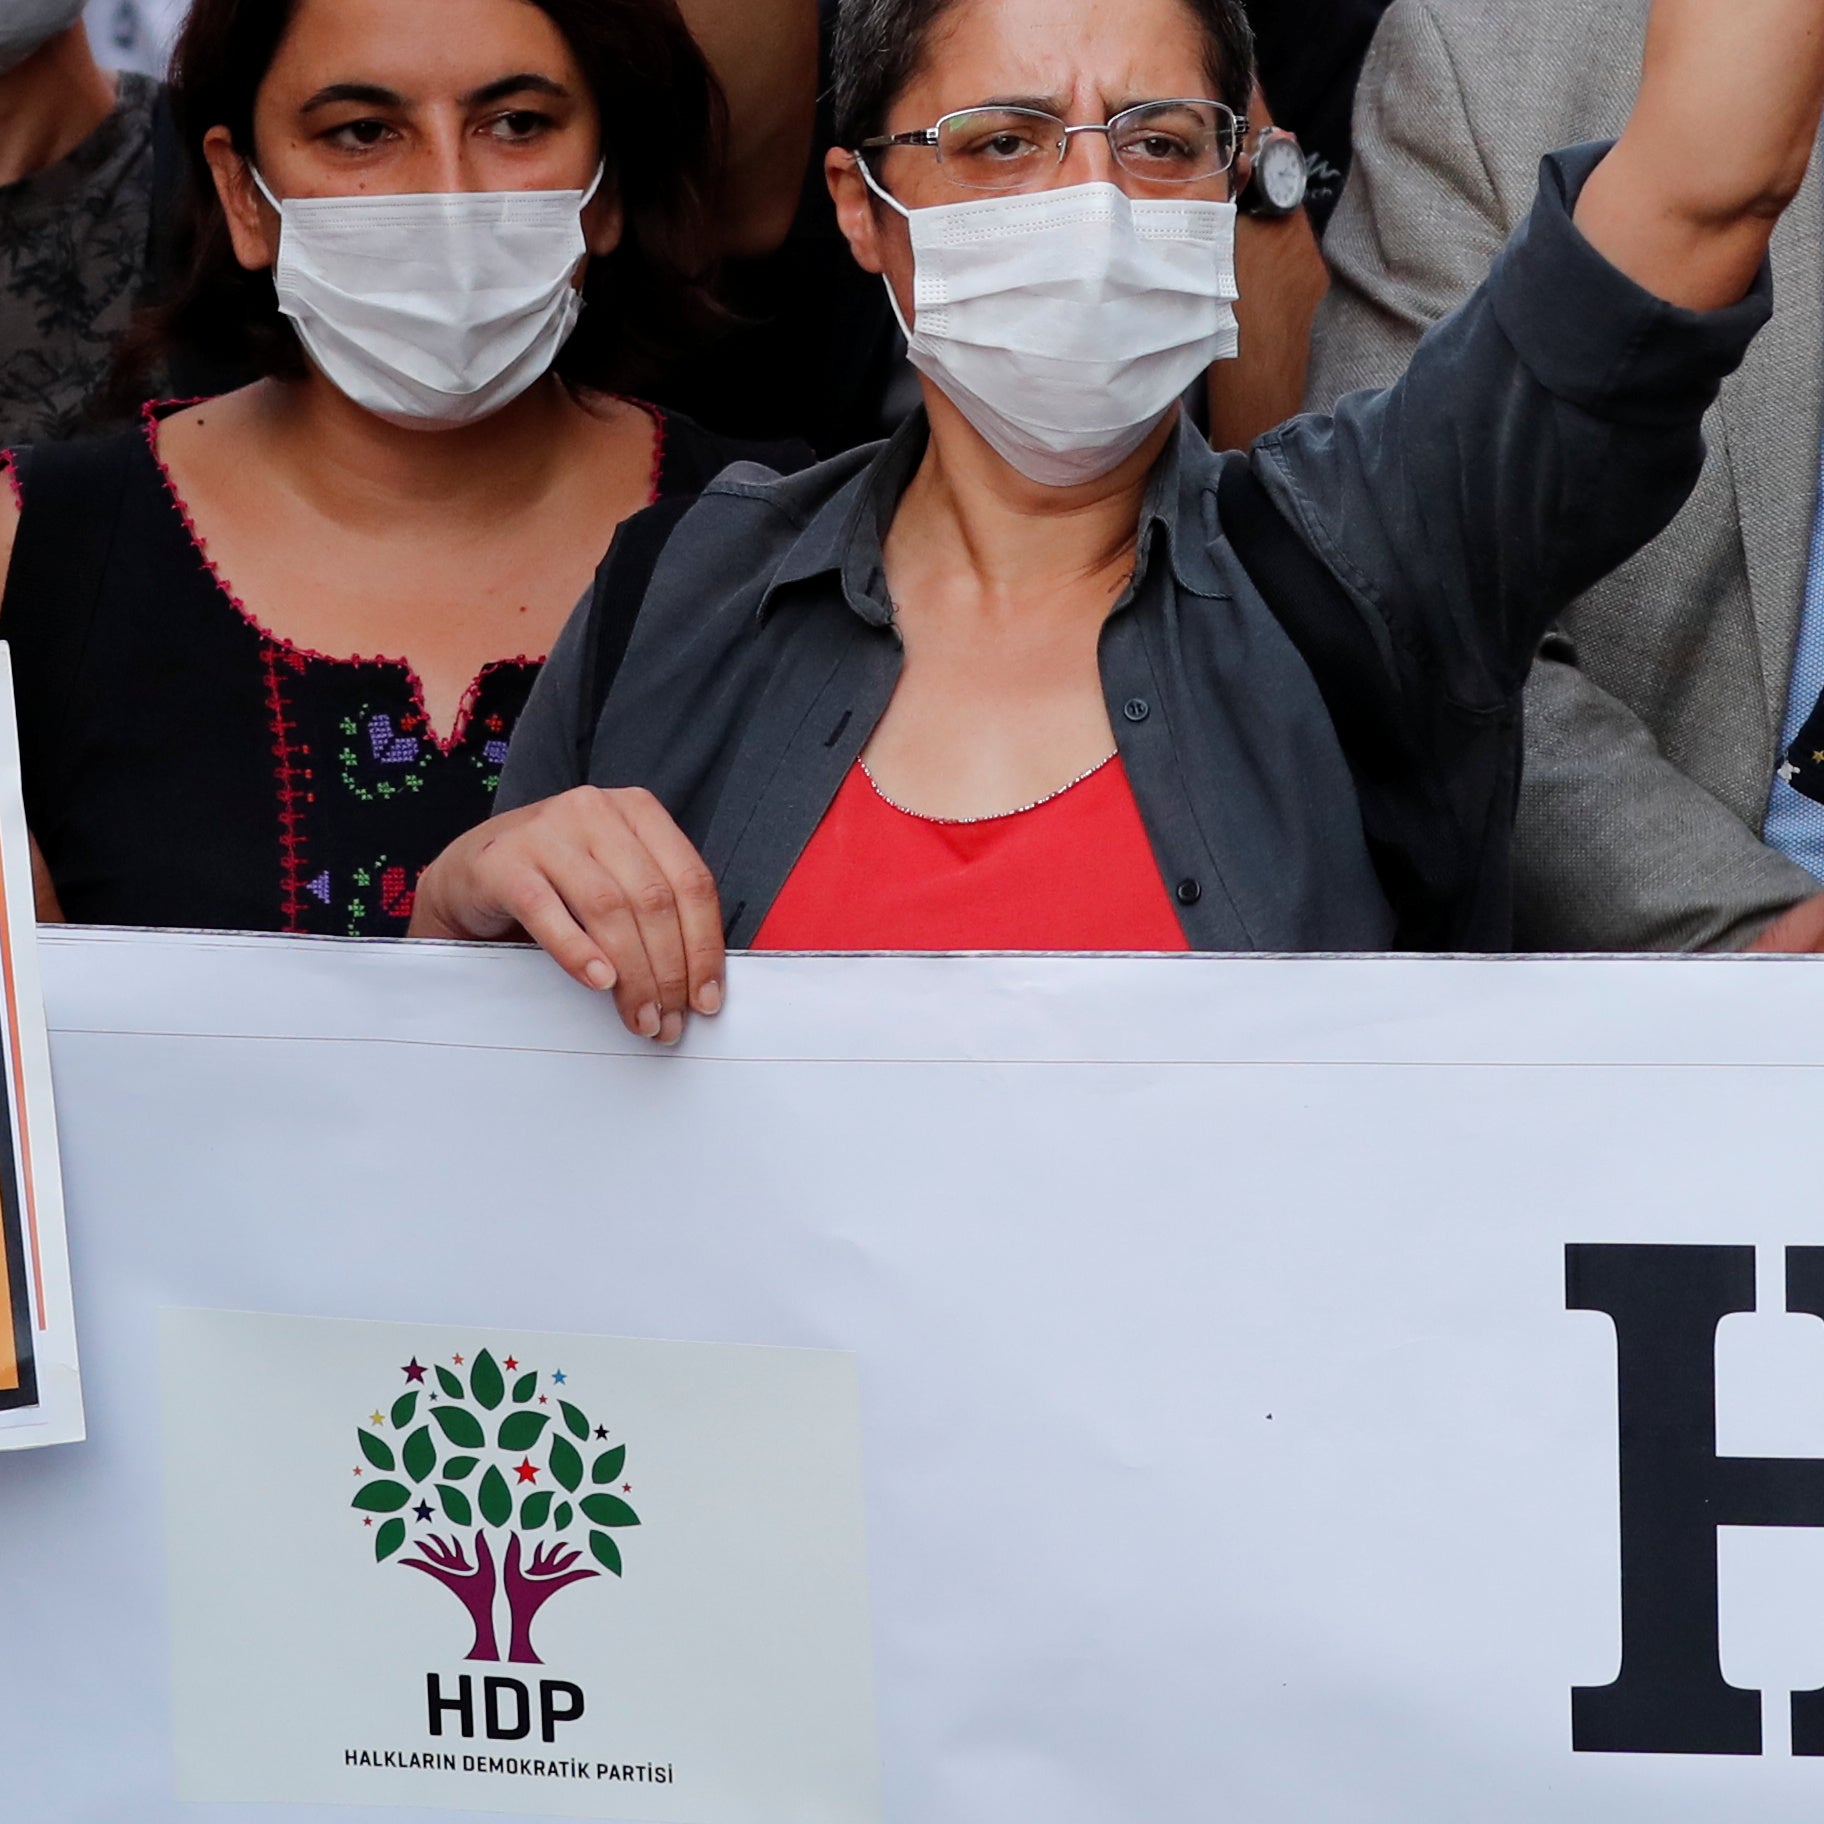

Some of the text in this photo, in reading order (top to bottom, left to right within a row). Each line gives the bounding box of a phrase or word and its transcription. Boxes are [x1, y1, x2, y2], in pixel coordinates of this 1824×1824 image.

[425, 1672, 586, 1744] HDP
[343, 1748, 675, 1785] HALKLARIN DEMOKRATİK PARTİSİ
